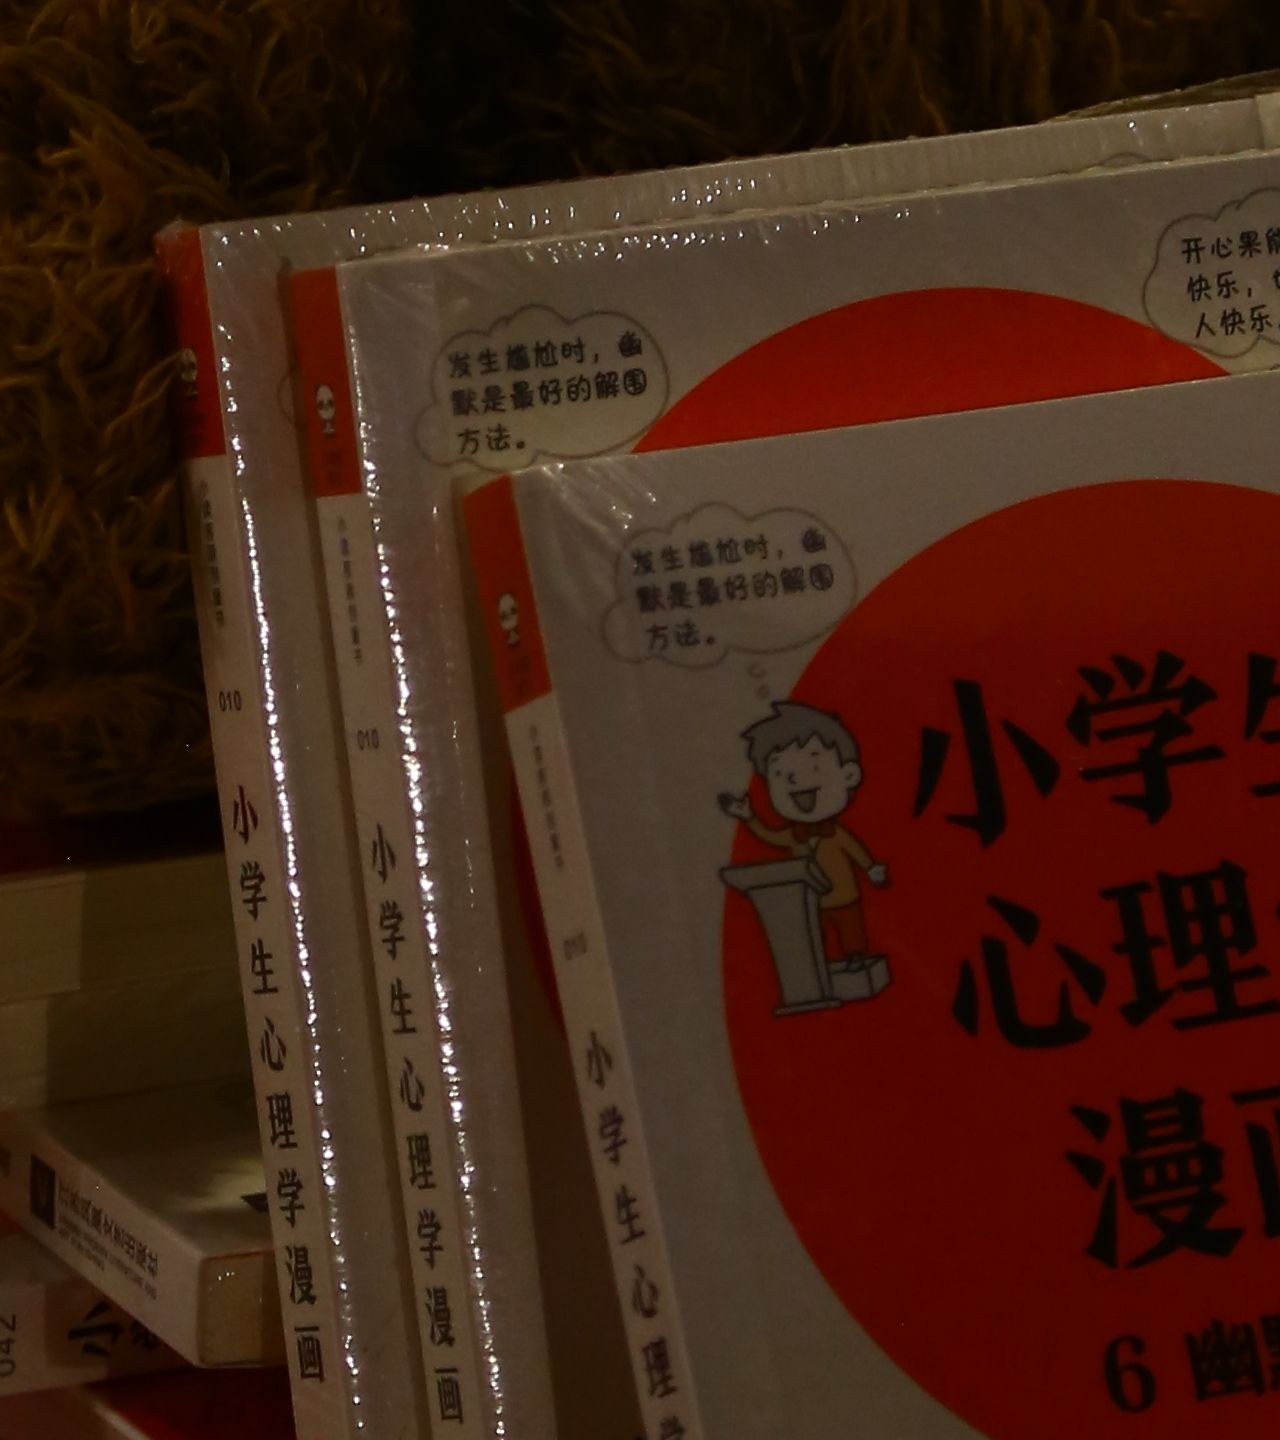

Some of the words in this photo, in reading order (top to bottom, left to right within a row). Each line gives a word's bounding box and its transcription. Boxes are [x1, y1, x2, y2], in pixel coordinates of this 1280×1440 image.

[451, 367, 648, 416] 默是最好的解围
[457, 424, 526, 456] 方法。
[645, 619, 717, 652] 方法。
[219, 690, 242, 712] 010
[357, 728, 380, 751] 010
[231, 784, 324, 1383] 小学生心理学漫画
[372, 823, 463, 1424] 小学生心理学漫画
[1104, 1332, 1157, 1412] 6
